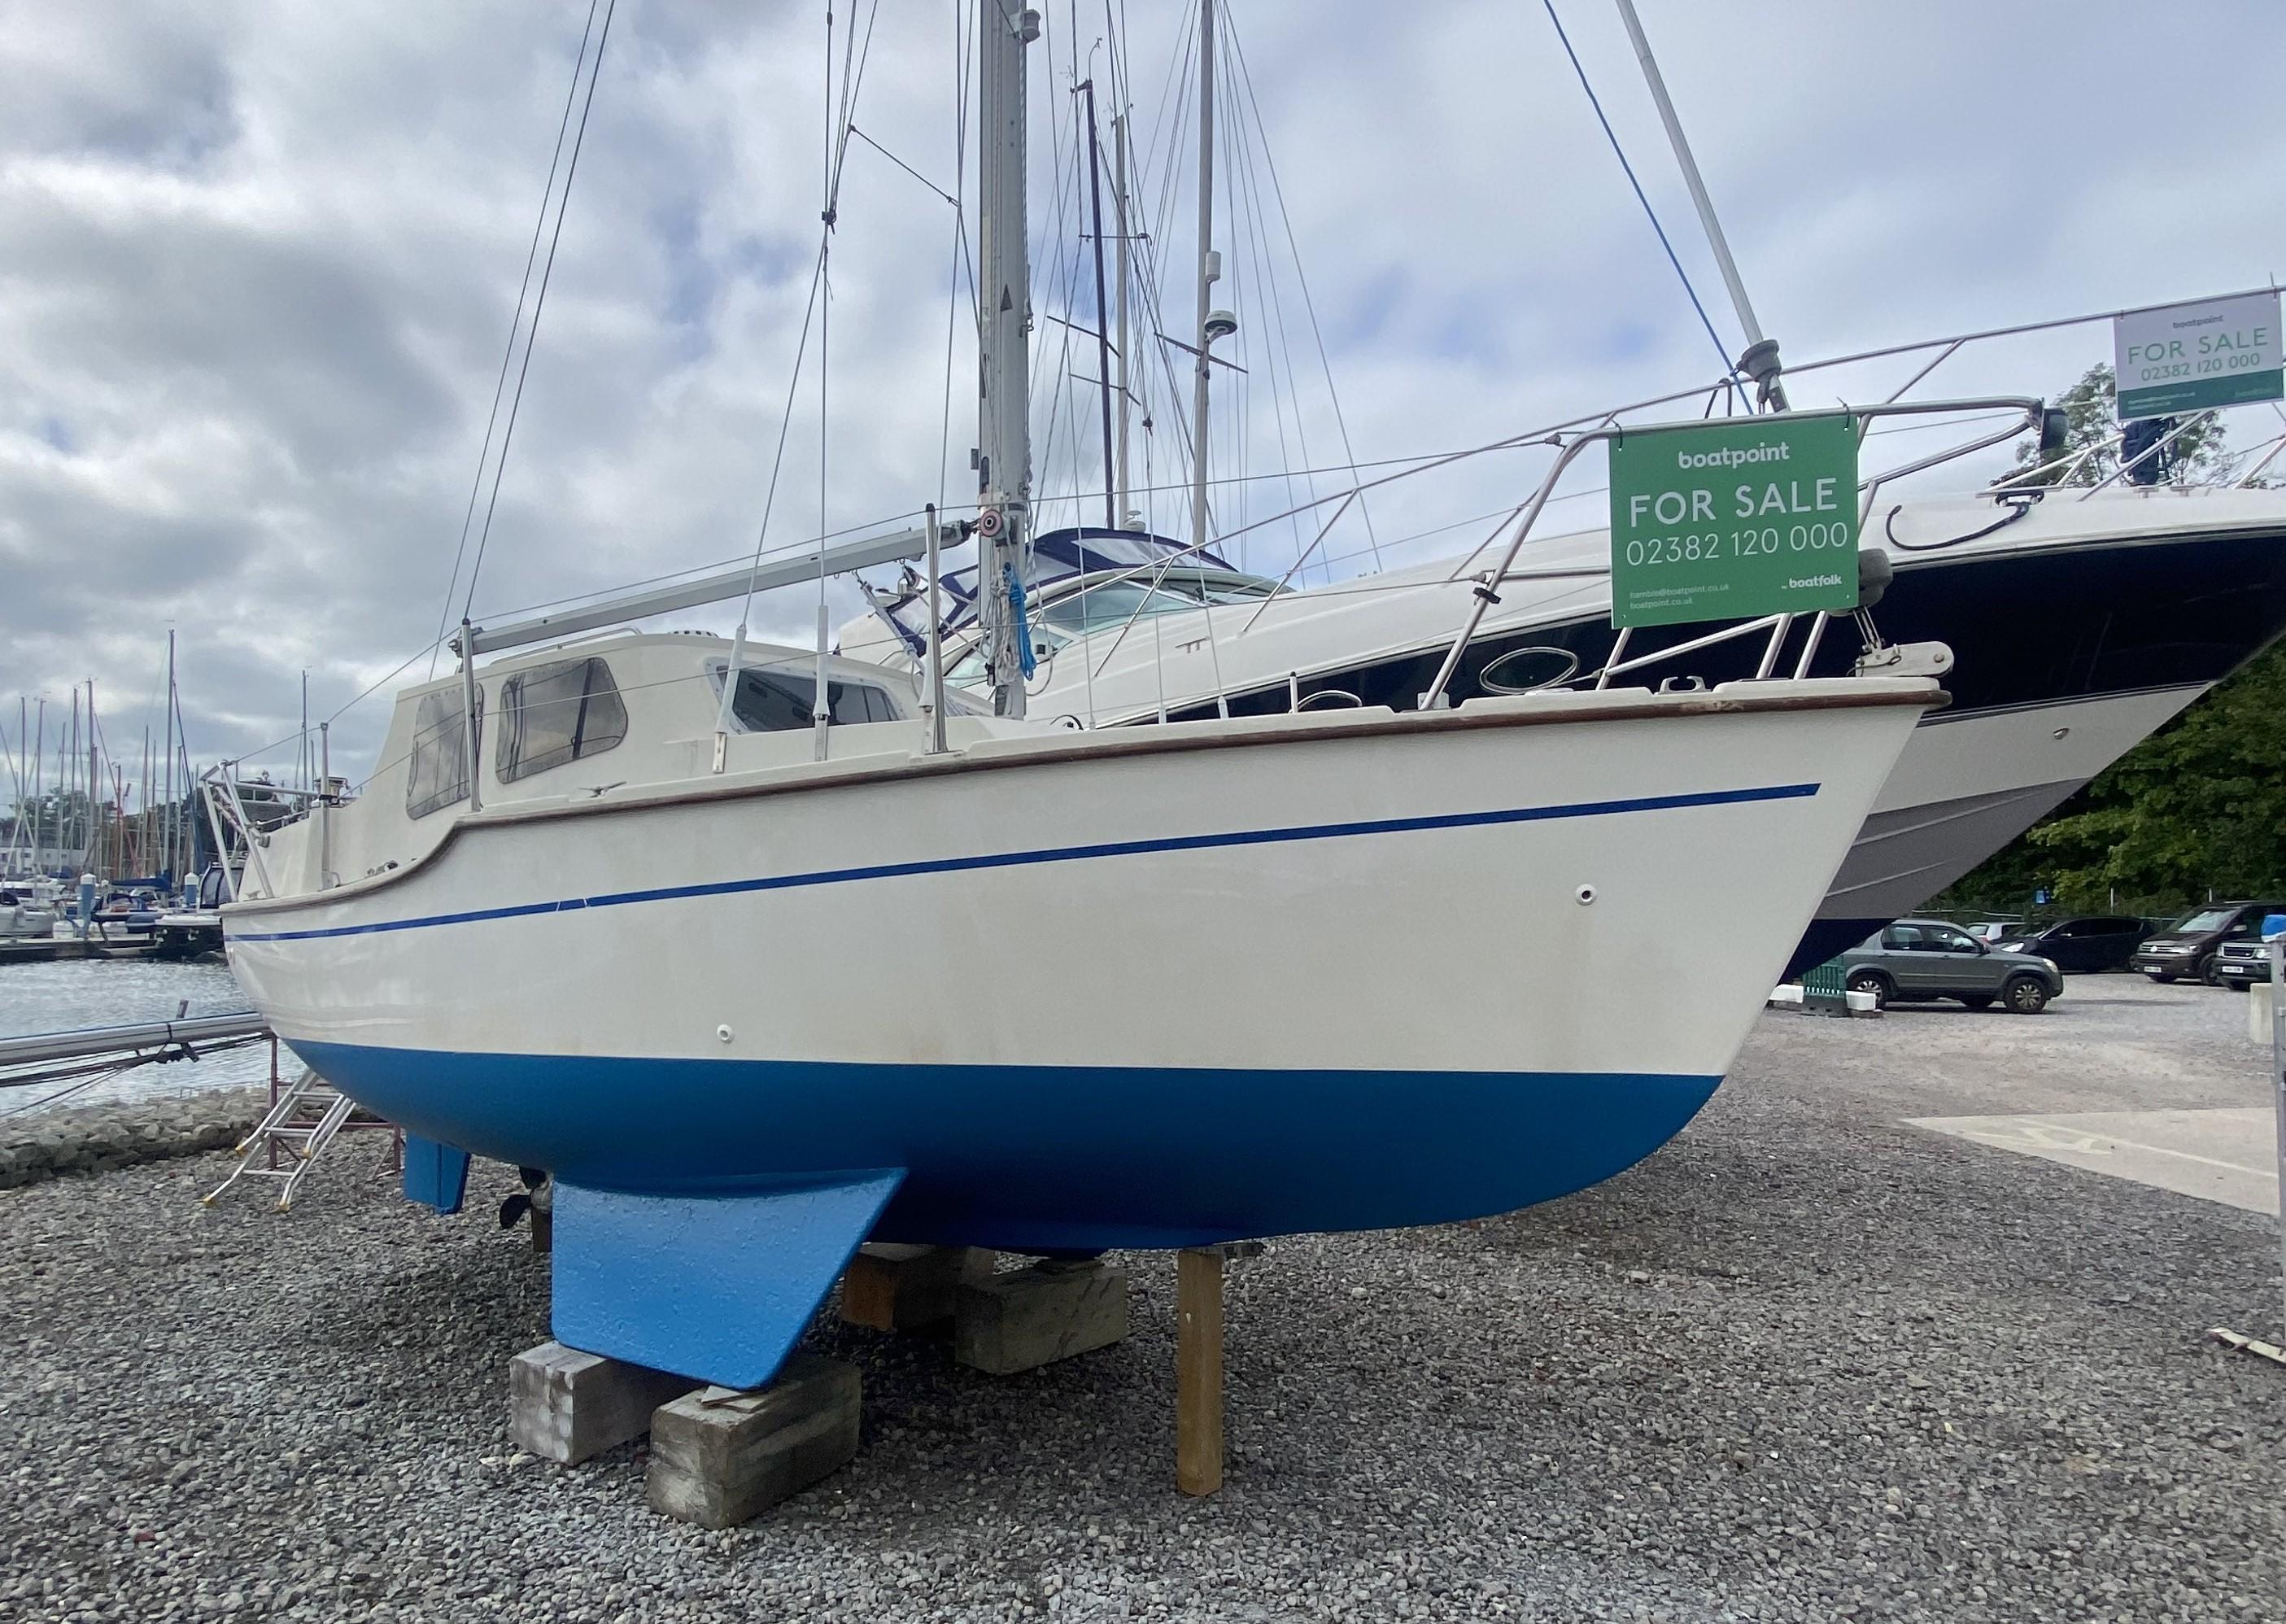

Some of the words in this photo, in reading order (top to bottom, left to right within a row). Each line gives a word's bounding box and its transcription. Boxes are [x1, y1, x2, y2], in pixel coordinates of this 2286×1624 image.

[2172, 315, 2225, 329] boatpoint
[2127, 340, 2185, 365] FOR
[2198, 327, 2268, 354] SALE
[2141, 362, 2191, 382] 02382
[2197, 358, 2222, 374] 120
[2228, 353, 2260, 368] 000
[1678, 441, 1790, 469] boatpoint
[1630, 490, 1717, 527] FOR
[1735, 477, 1837, 518] SALE
[1626, 532, 1720, 565] 02382
[1730, 527, 1778, 557] 120
[1790, 522, 1848, 551] 000
[1789, 573, 1842, 588] boatfolk
